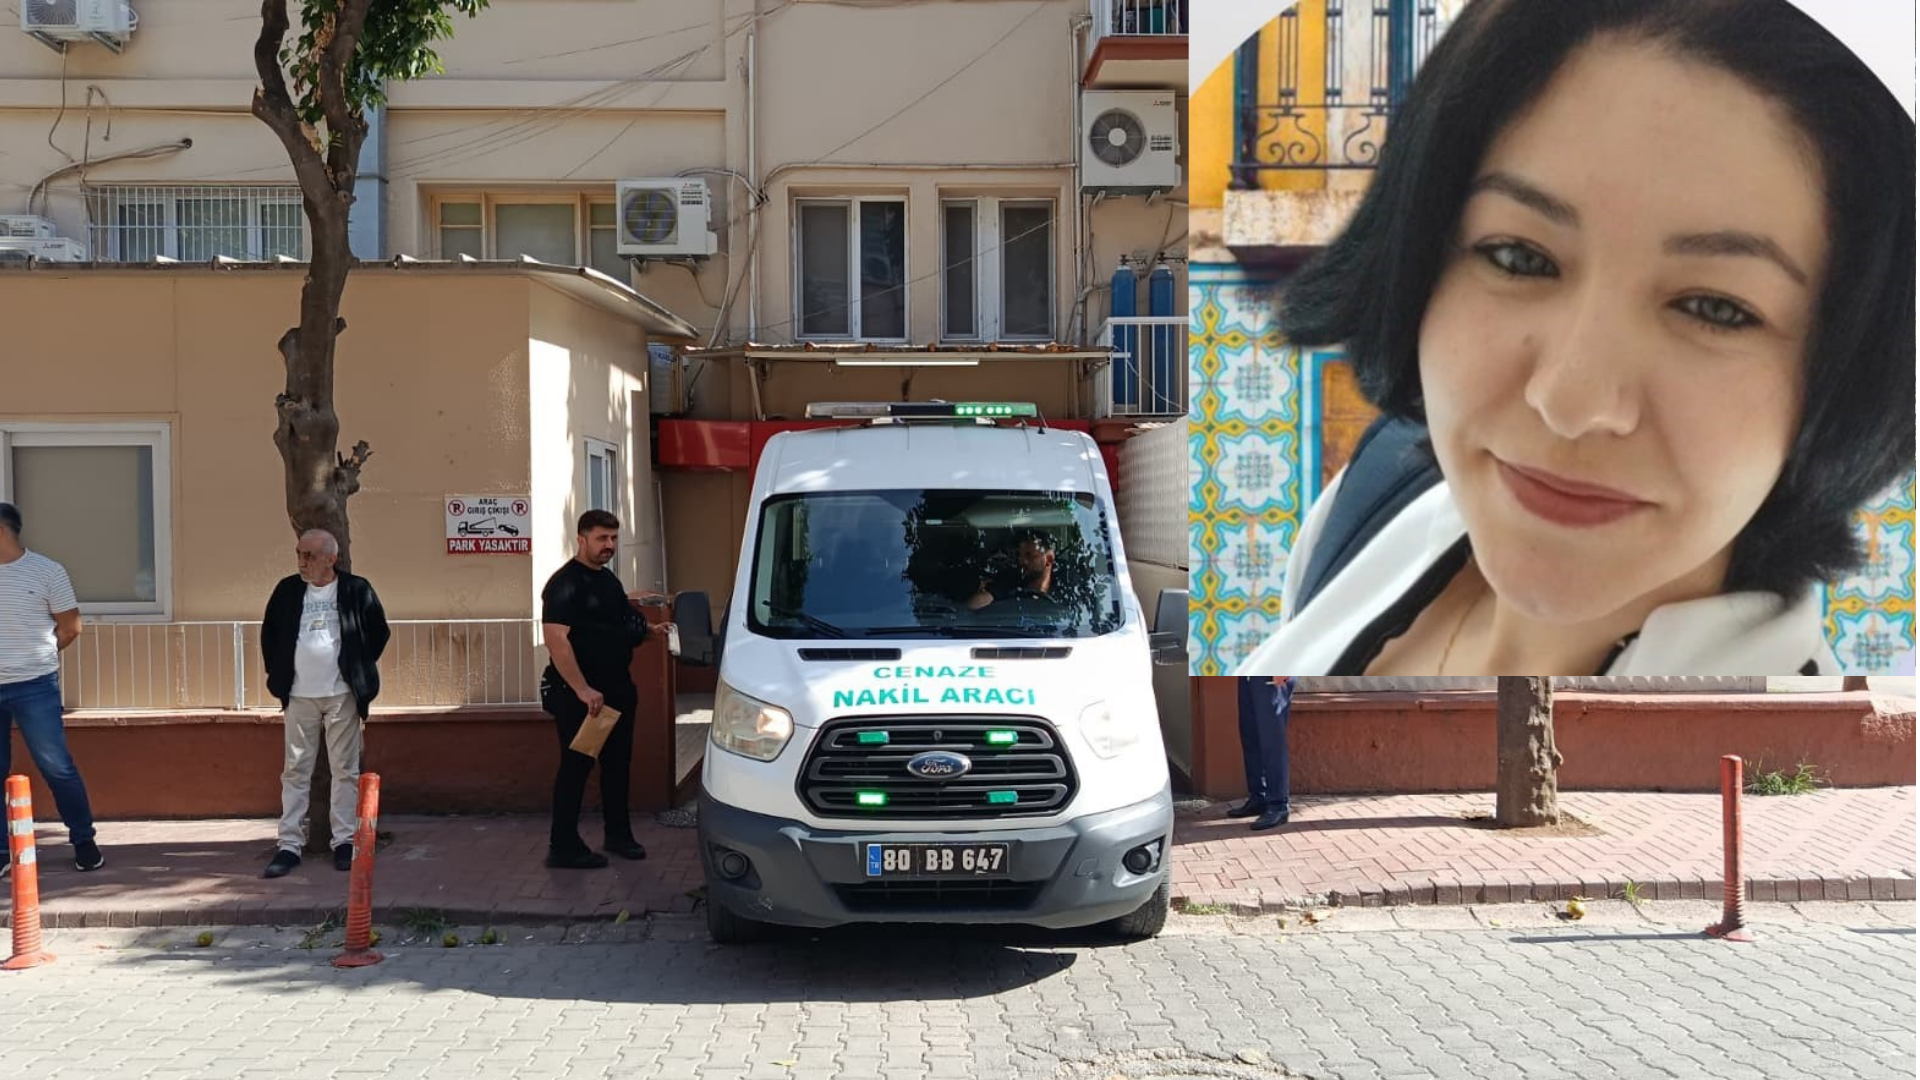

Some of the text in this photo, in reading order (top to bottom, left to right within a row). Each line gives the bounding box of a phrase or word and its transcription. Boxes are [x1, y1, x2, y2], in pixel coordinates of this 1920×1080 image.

[449, 539, 528, 551] PARK YASAKTIR
[873, 666, 995, 679] CENAZE
[833, 683, 1035, 708] NAKİL ARACI
[920, 759, 953, 774] Ford
[883, 848, 1003, 871] 80 BB 647
